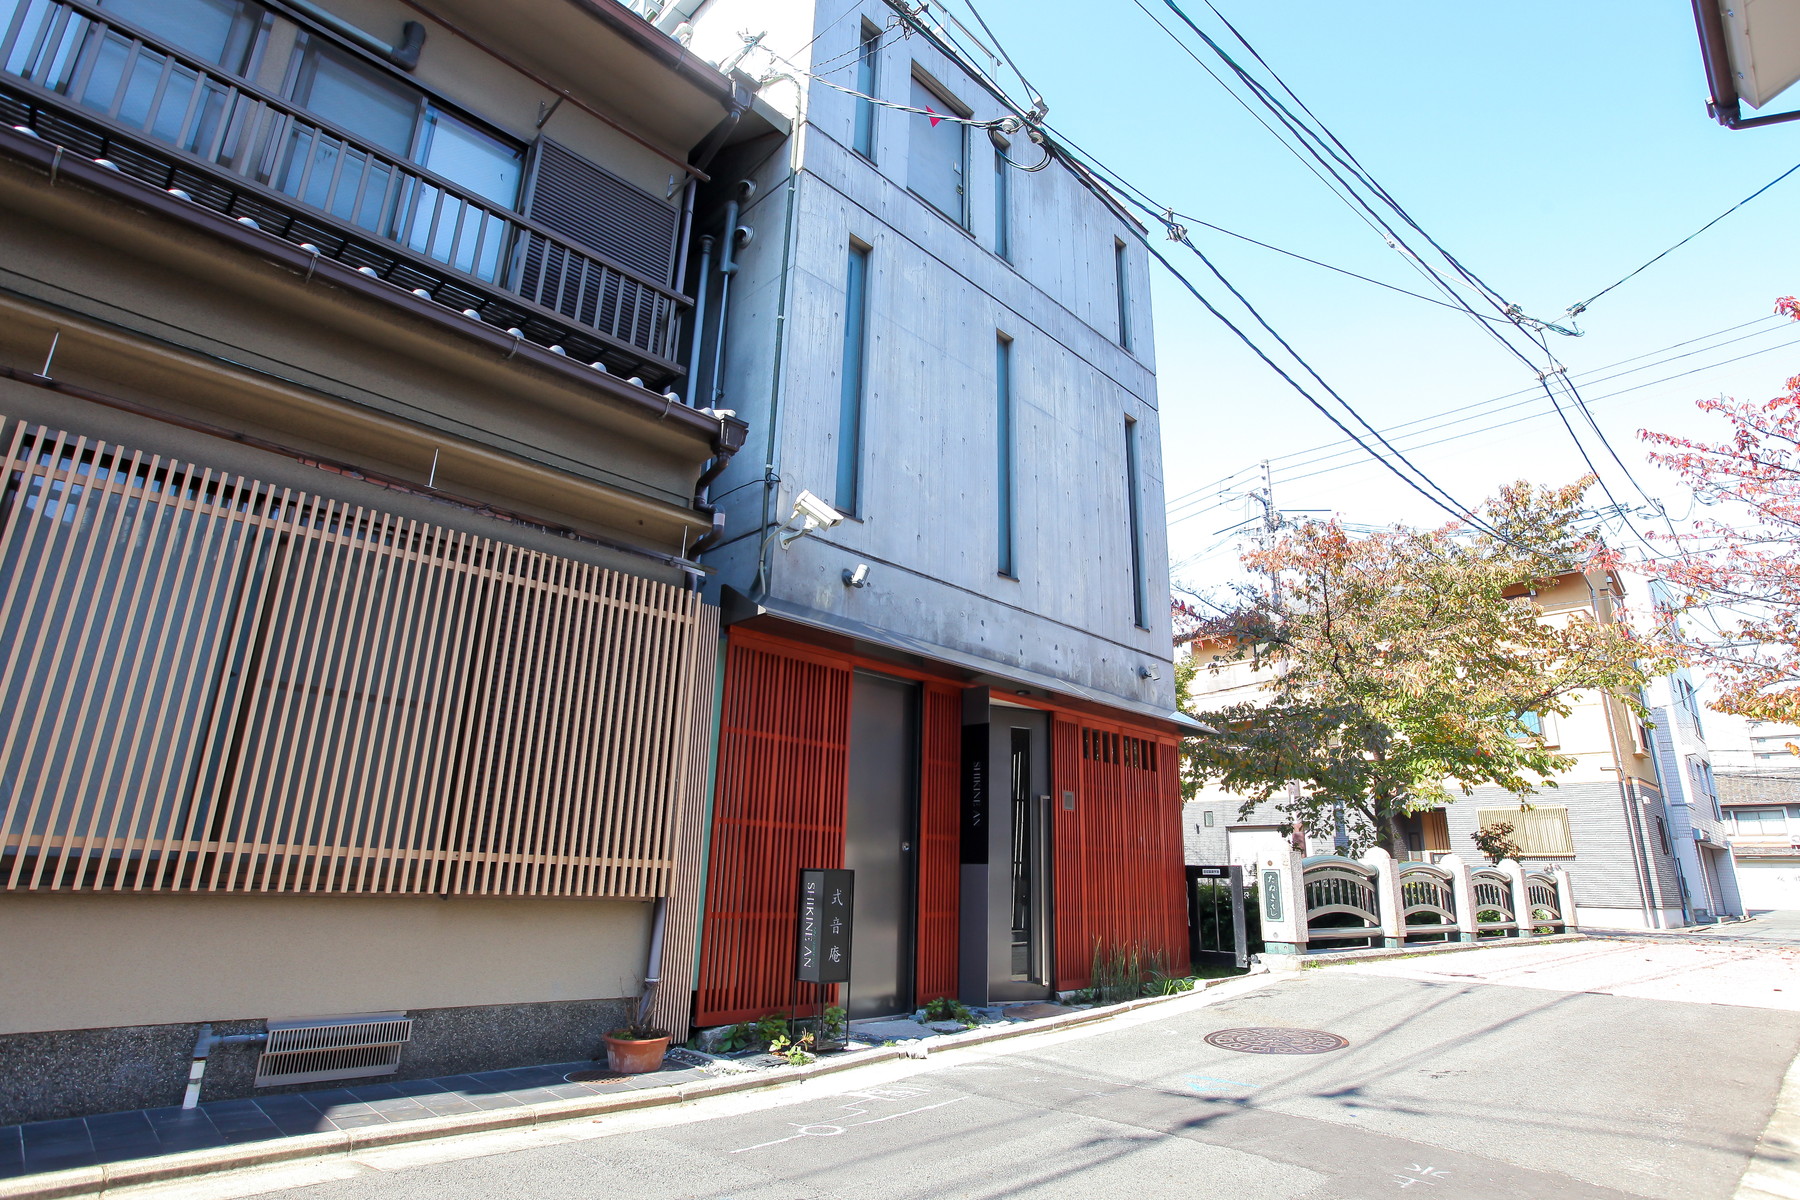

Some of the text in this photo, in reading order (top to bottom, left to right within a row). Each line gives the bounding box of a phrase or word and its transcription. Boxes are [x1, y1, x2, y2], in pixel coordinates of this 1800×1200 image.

[972, 761, 981, 827] SHIKINE AN
[804, 882, 816, 942] SHIKINE
[827, 888, 843, 963] 式音庵
[803, 945, 813, 968] AN
